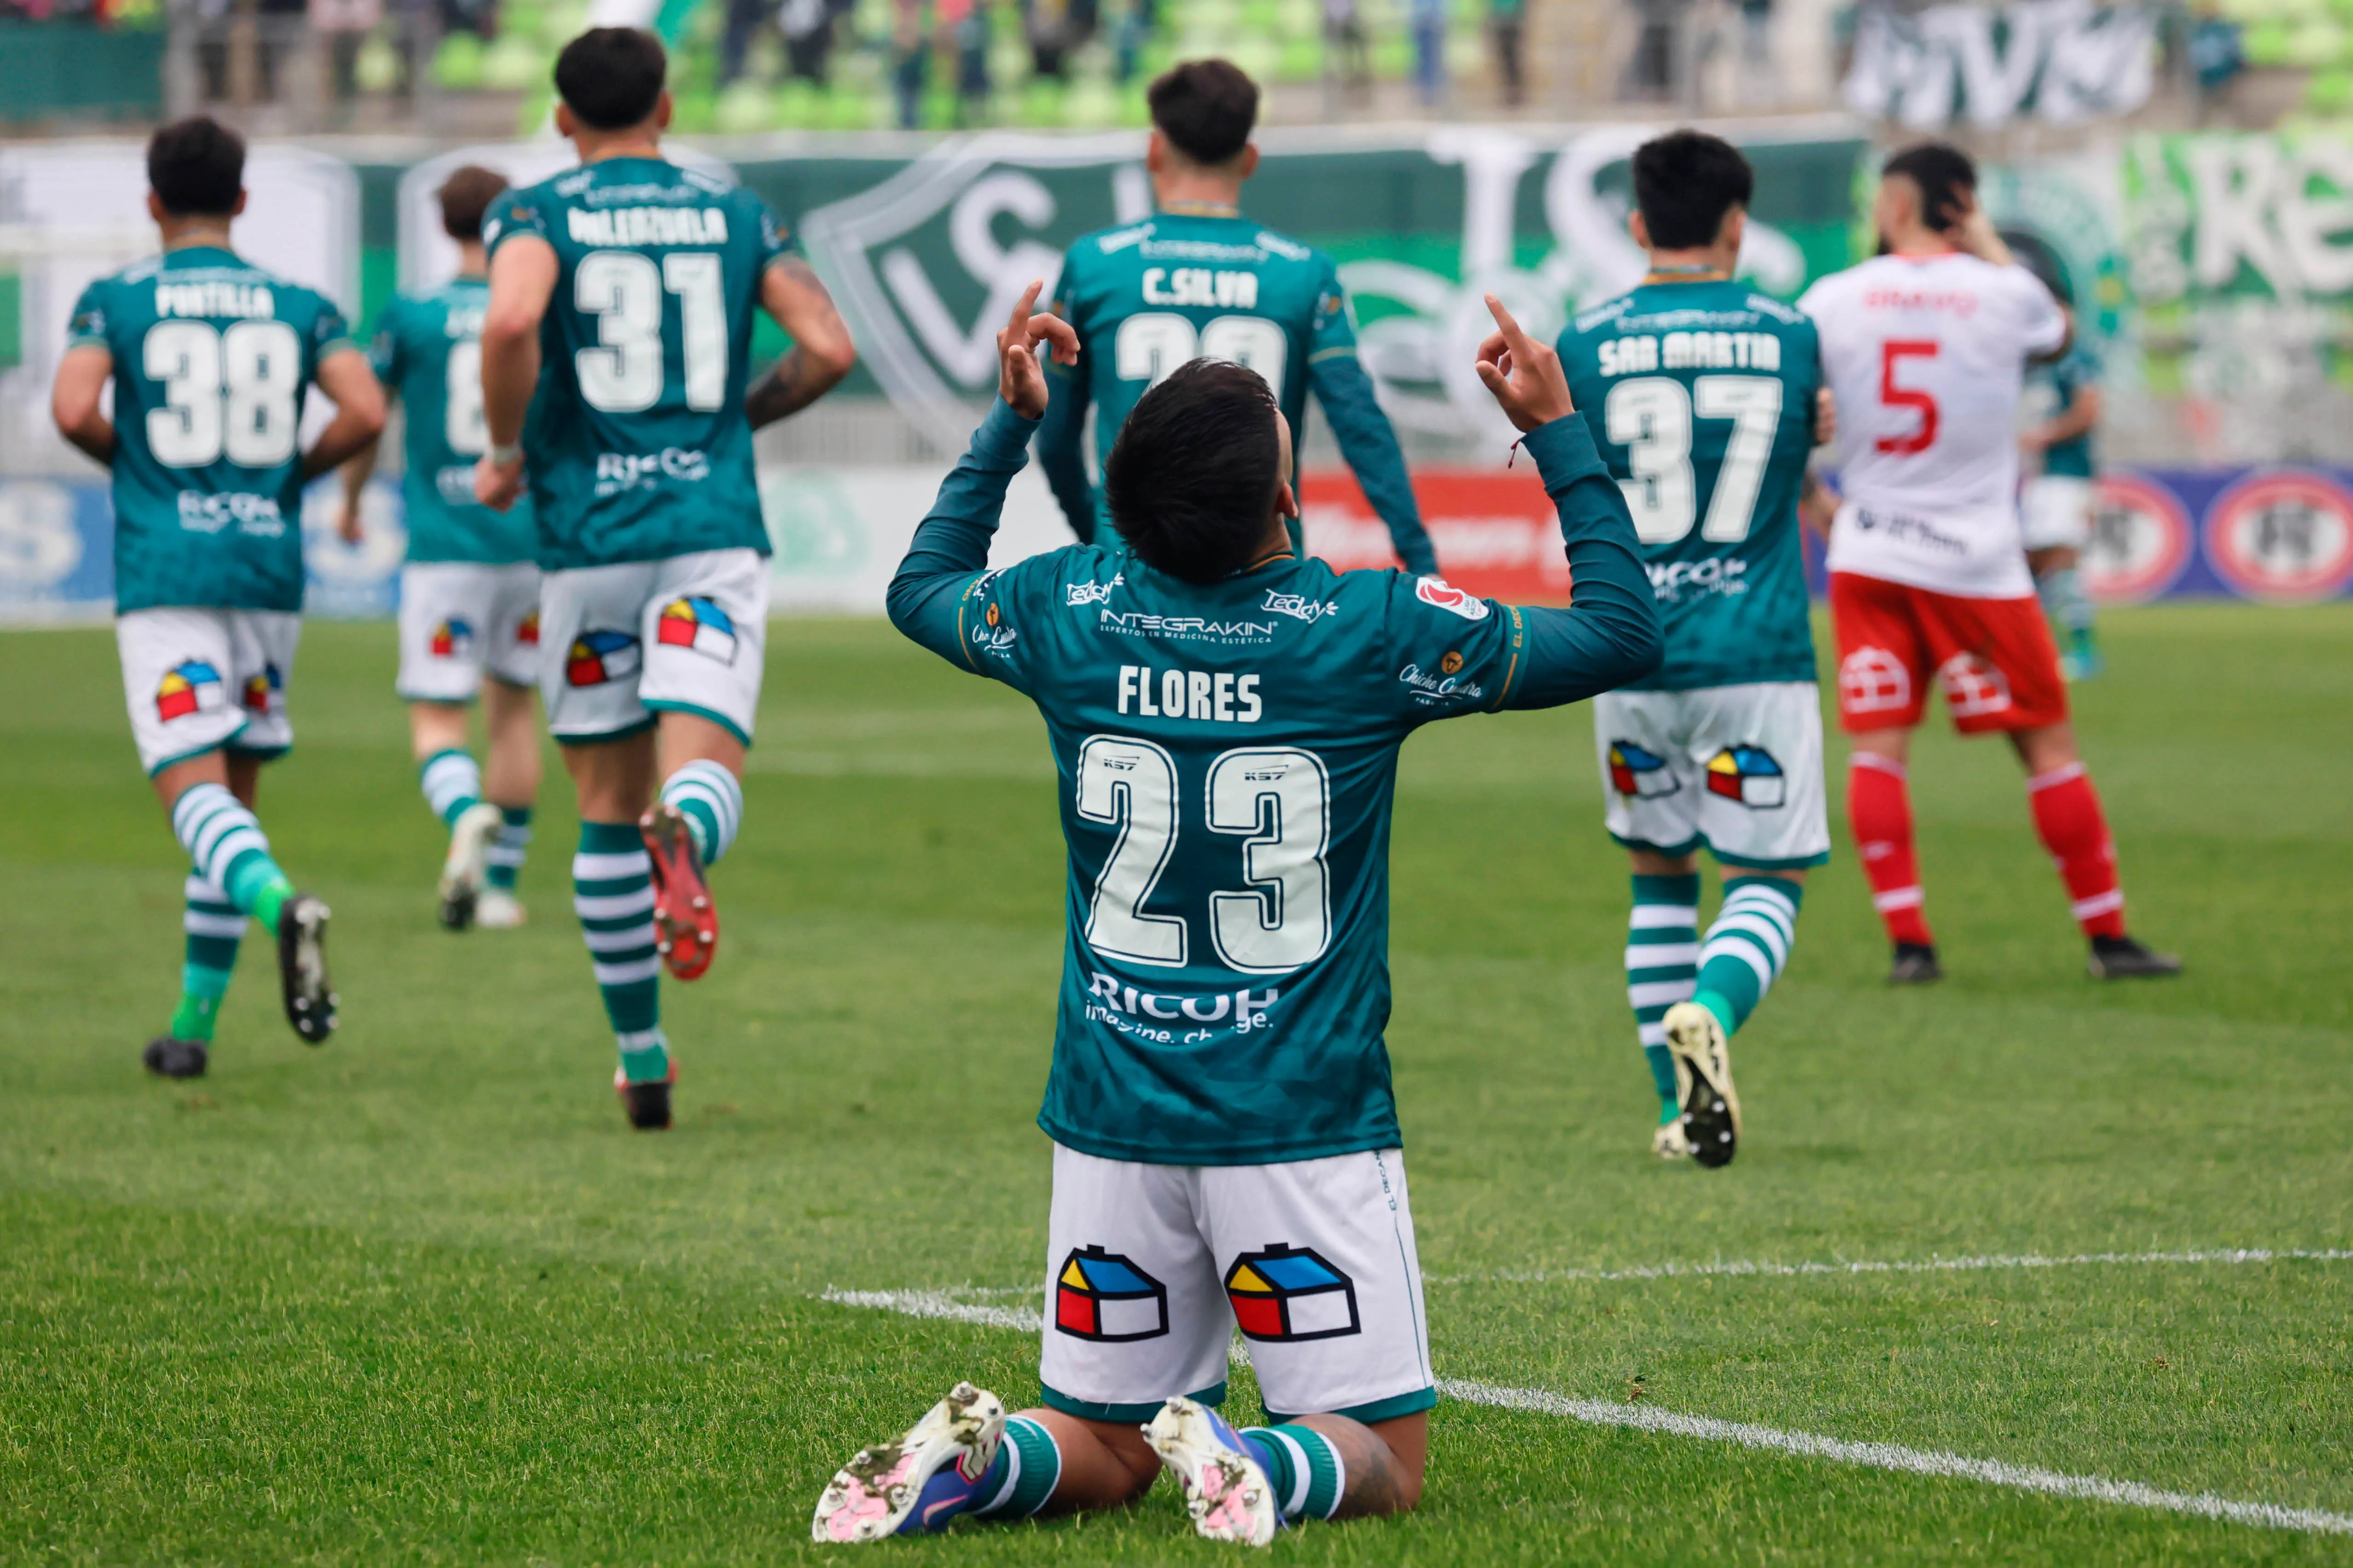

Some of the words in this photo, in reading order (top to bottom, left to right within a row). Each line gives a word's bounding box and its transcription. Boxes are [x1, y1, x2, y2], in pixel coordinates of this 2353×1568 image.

[573, 249, 728, 413] 31
[143, 318, 300, 469] 38
[1874, 340, 1939, 453] 5
[1604, 374, 1783, 544] 37
[1100, 625, 1145, 637] EXPERTOS
[1165, 632, 1216, 643] MEDICINA
[1101, 609, 1273, 636] INTEGRAKIN
[1260, 588, 1333, 624] Teddy
[1118, 665, 1262, 722] FLORES
[1076, 733, 1332, 975] 23
[1088, 972, 1279, 1021] RICOH
